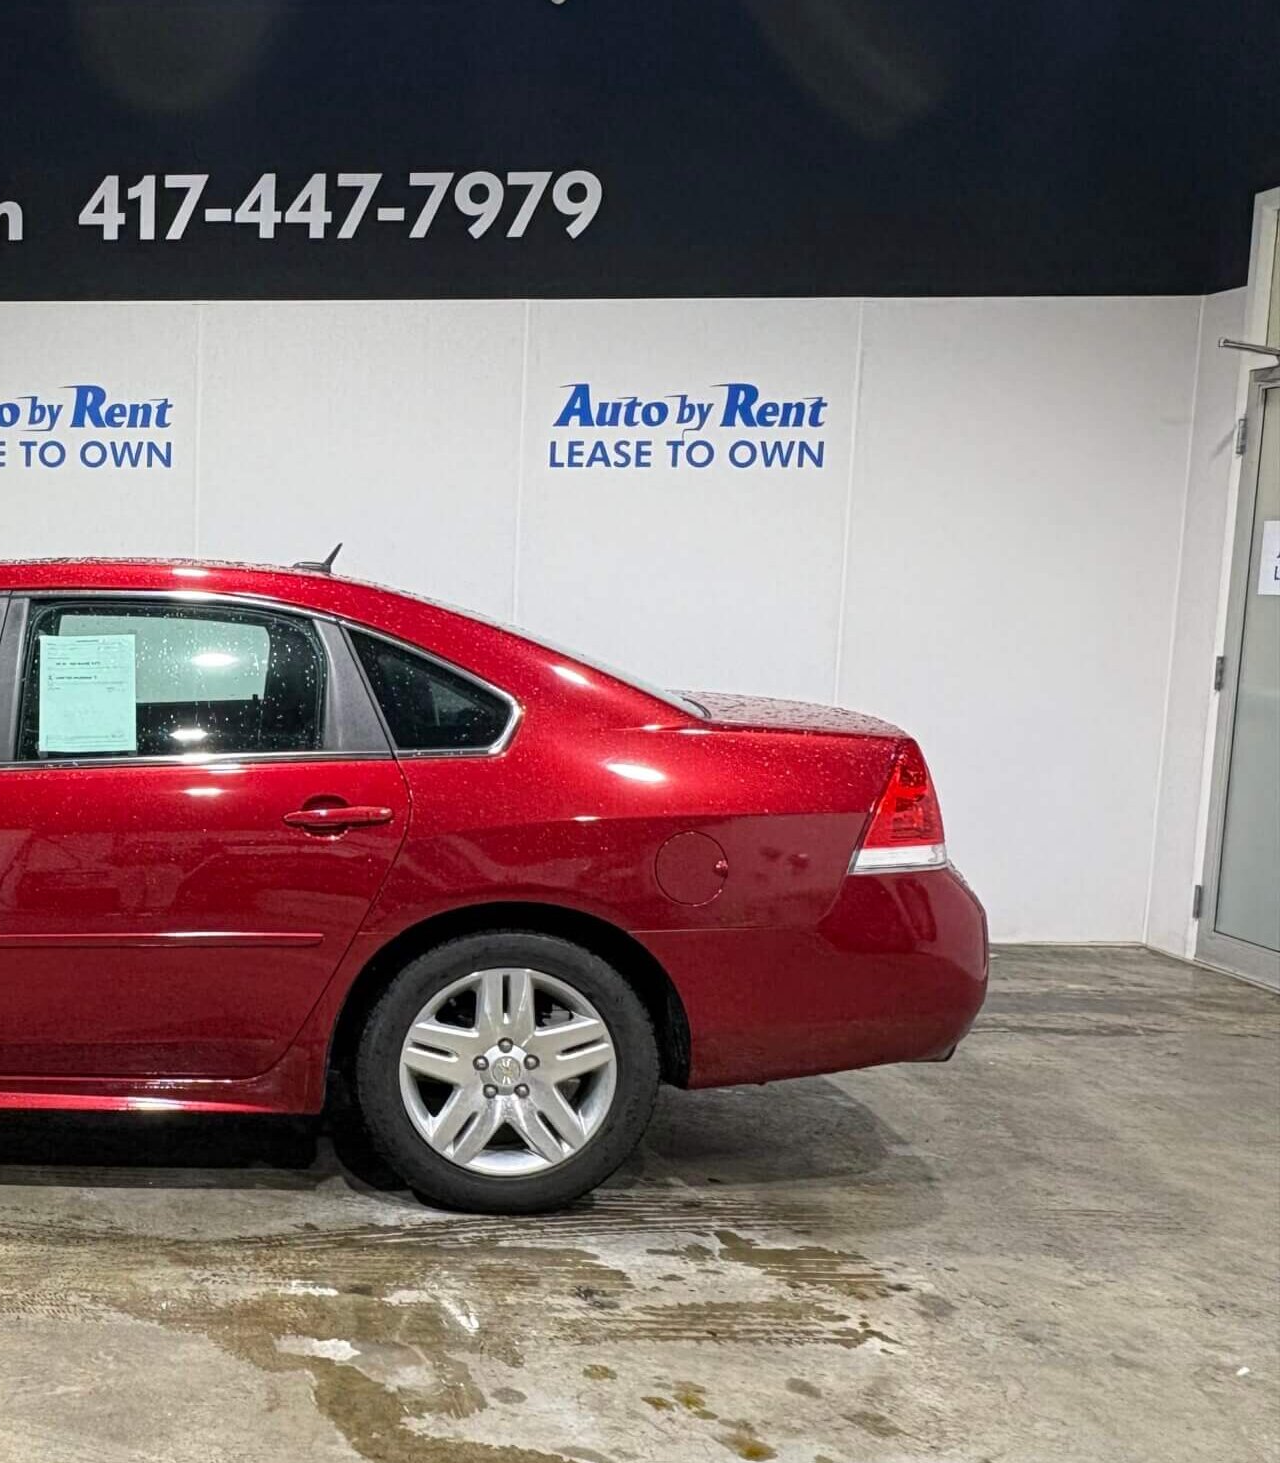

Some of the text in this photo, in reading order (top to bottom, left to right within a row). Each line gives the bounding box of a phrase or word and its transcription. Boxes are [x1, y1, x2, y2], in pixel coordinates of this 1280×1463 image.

[78, 169, 603, 240] 417-447-7979
[16, 396, 63, 432] by
[58, 384, 173, 428] Rent
[552, 383, 828, 432] Auto by Rent
[20, 440, 66, 468] TO
[79, 440, 172, 468] OWN
[549, 439, 825, 468] LEASE TO OWN
